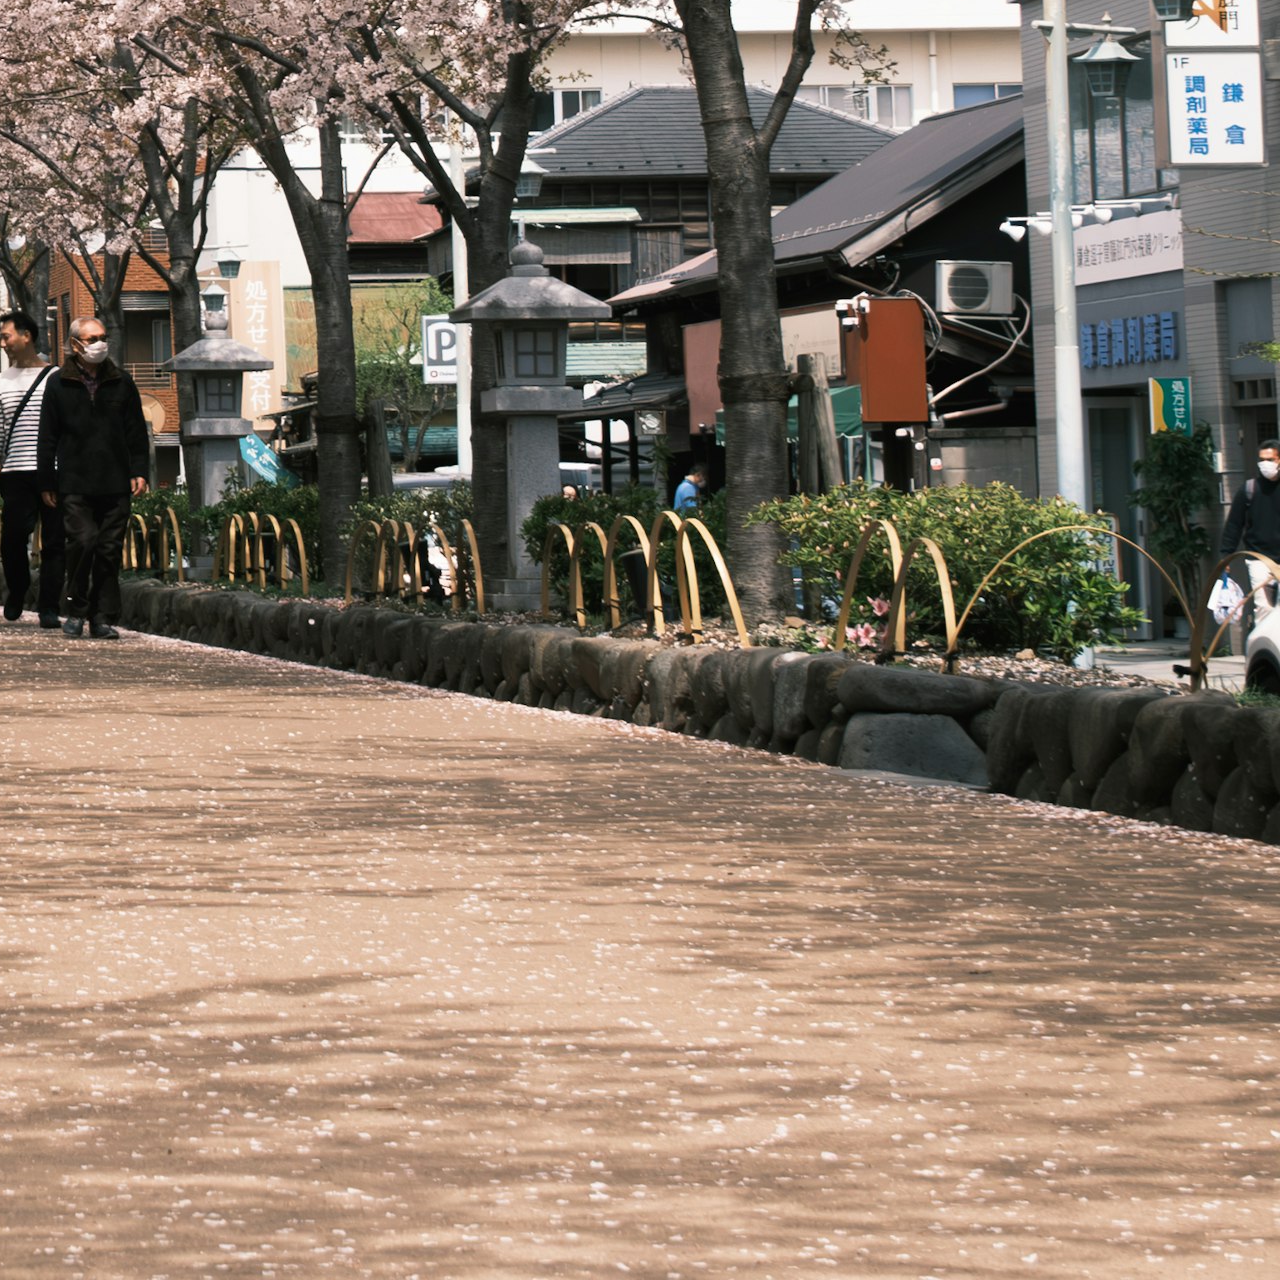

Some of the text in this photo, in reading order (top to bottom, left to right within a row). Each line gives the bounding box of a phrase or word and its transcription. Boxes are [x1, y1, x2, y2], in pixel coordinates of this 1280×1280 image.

[1172, 56, 1190, 69] 1F
[1184, 74, 1210, 156] 調剤薬局
[245, 279, 272, 412] 処方せ受付
[434, 328, 456, 361] P
